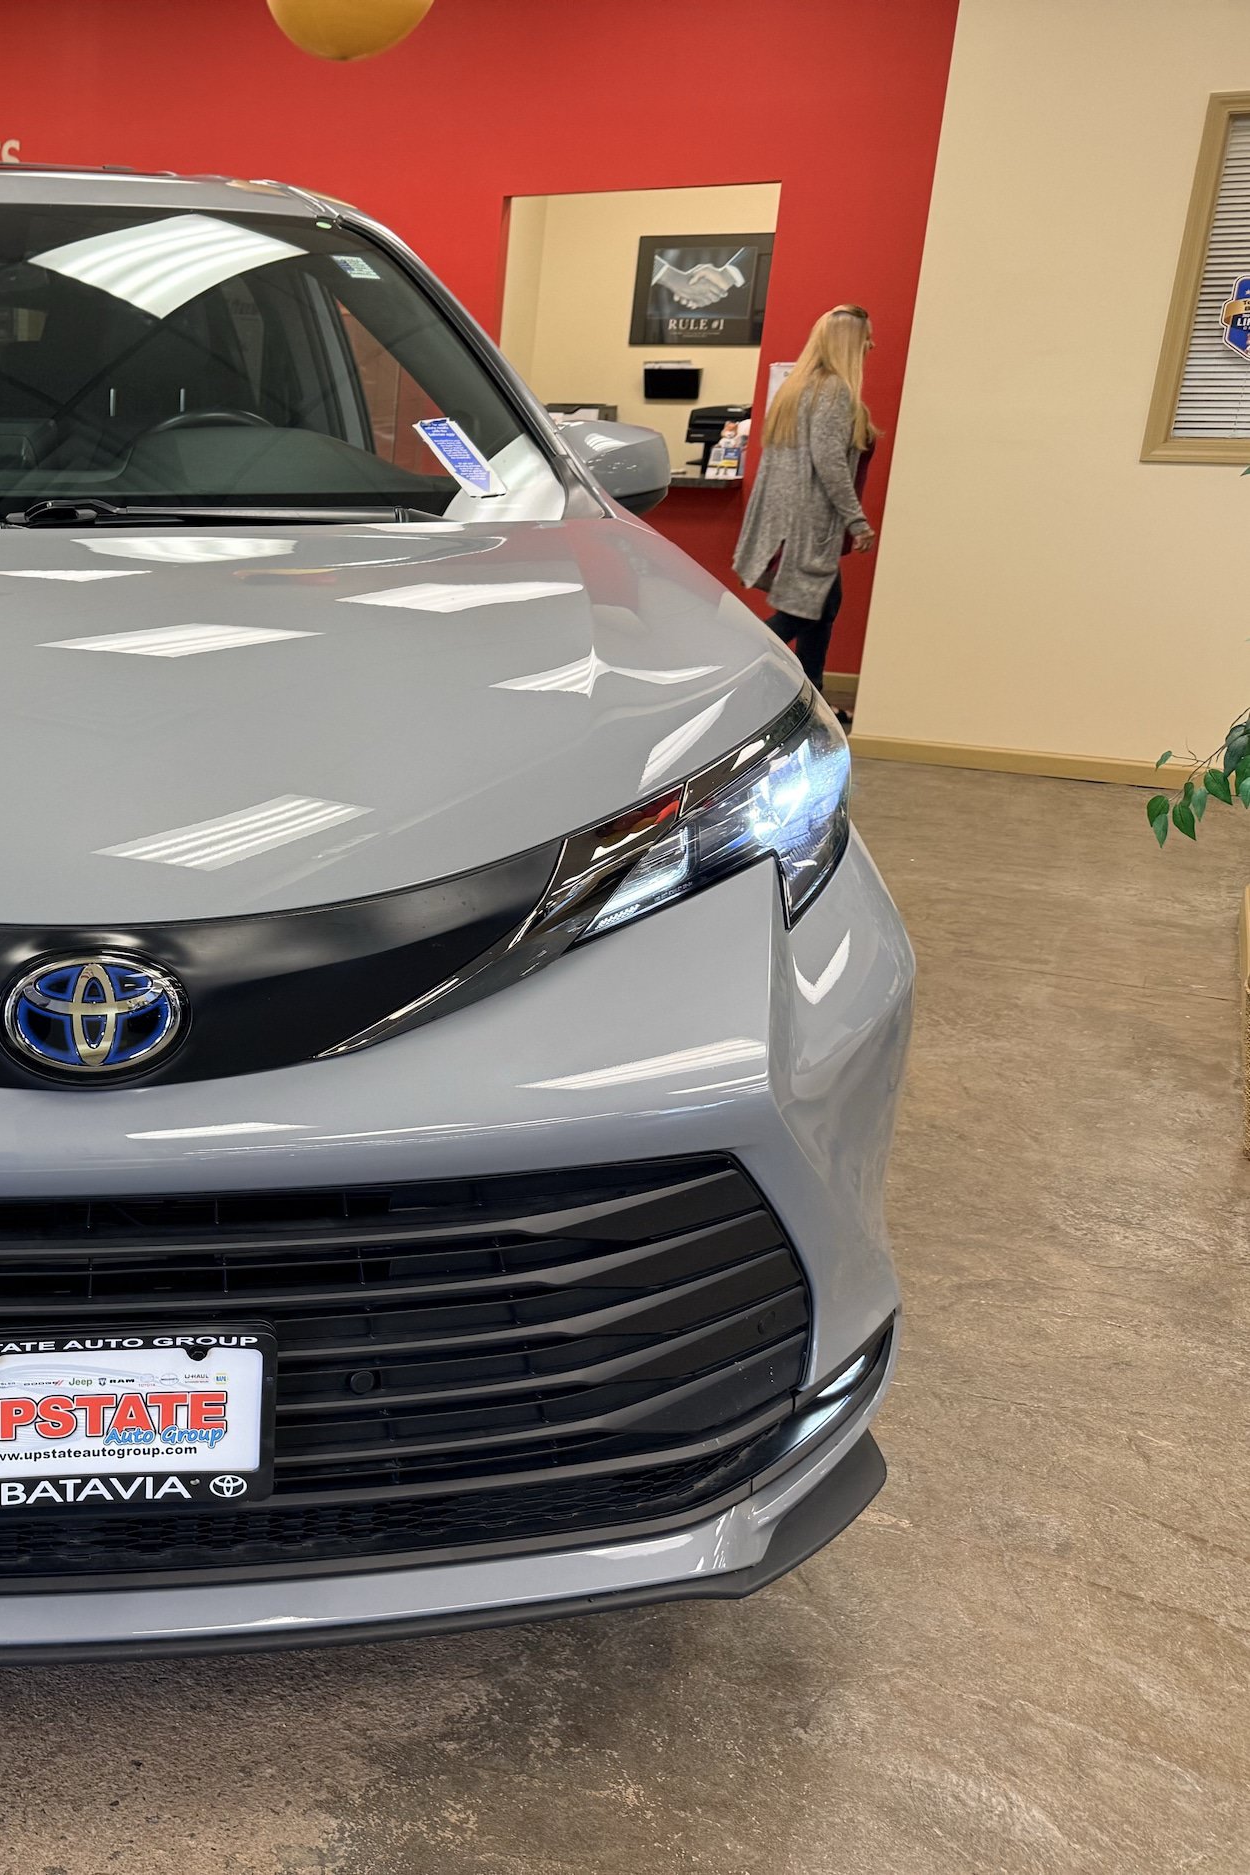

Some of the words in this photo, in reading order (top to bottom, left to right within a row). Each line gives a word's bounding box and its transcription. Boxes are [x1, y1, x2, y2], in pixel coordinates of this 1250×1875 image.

[668, 318, 709, 330] RULE
[63, 1338, 144, 1350] AUTO
[152, 1336, 258, 1347] GROUP
[68, 1377, 93, 1387] Jeep
[103, 1427, 156, 1446] Auto
[160, 1425, 226, 1448] Group
[1, 1476, 192, 1506] BATAVIA
